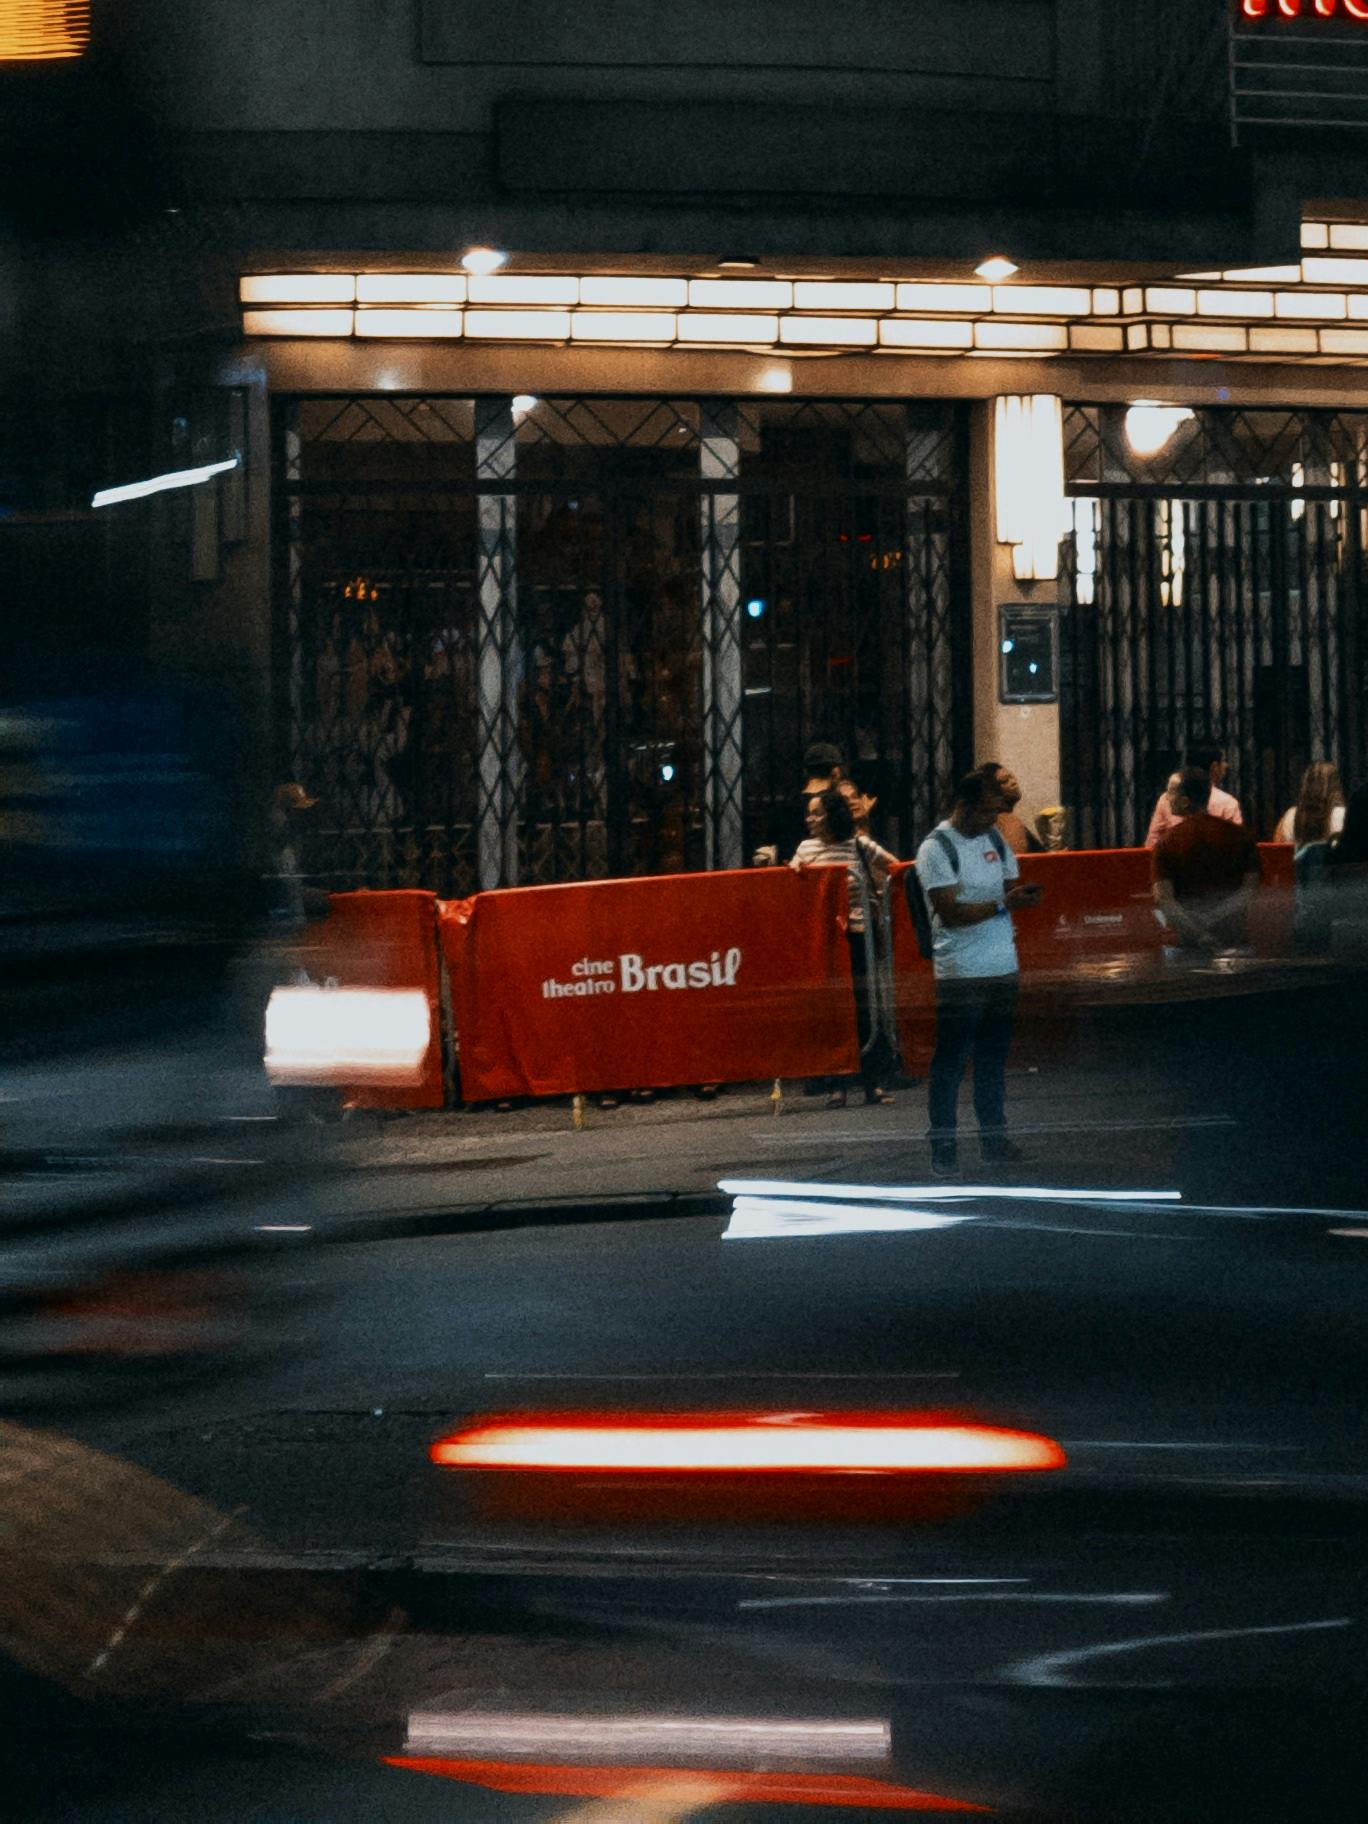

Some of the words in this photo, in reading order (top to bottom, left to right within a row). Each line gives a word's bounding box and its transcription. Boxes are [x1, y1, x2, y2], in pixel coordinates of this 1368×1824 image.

[571, 957, 615, 976] cine
[618, 947, 741, 993] Brasil
[542, 978, 615, 999] theatro
